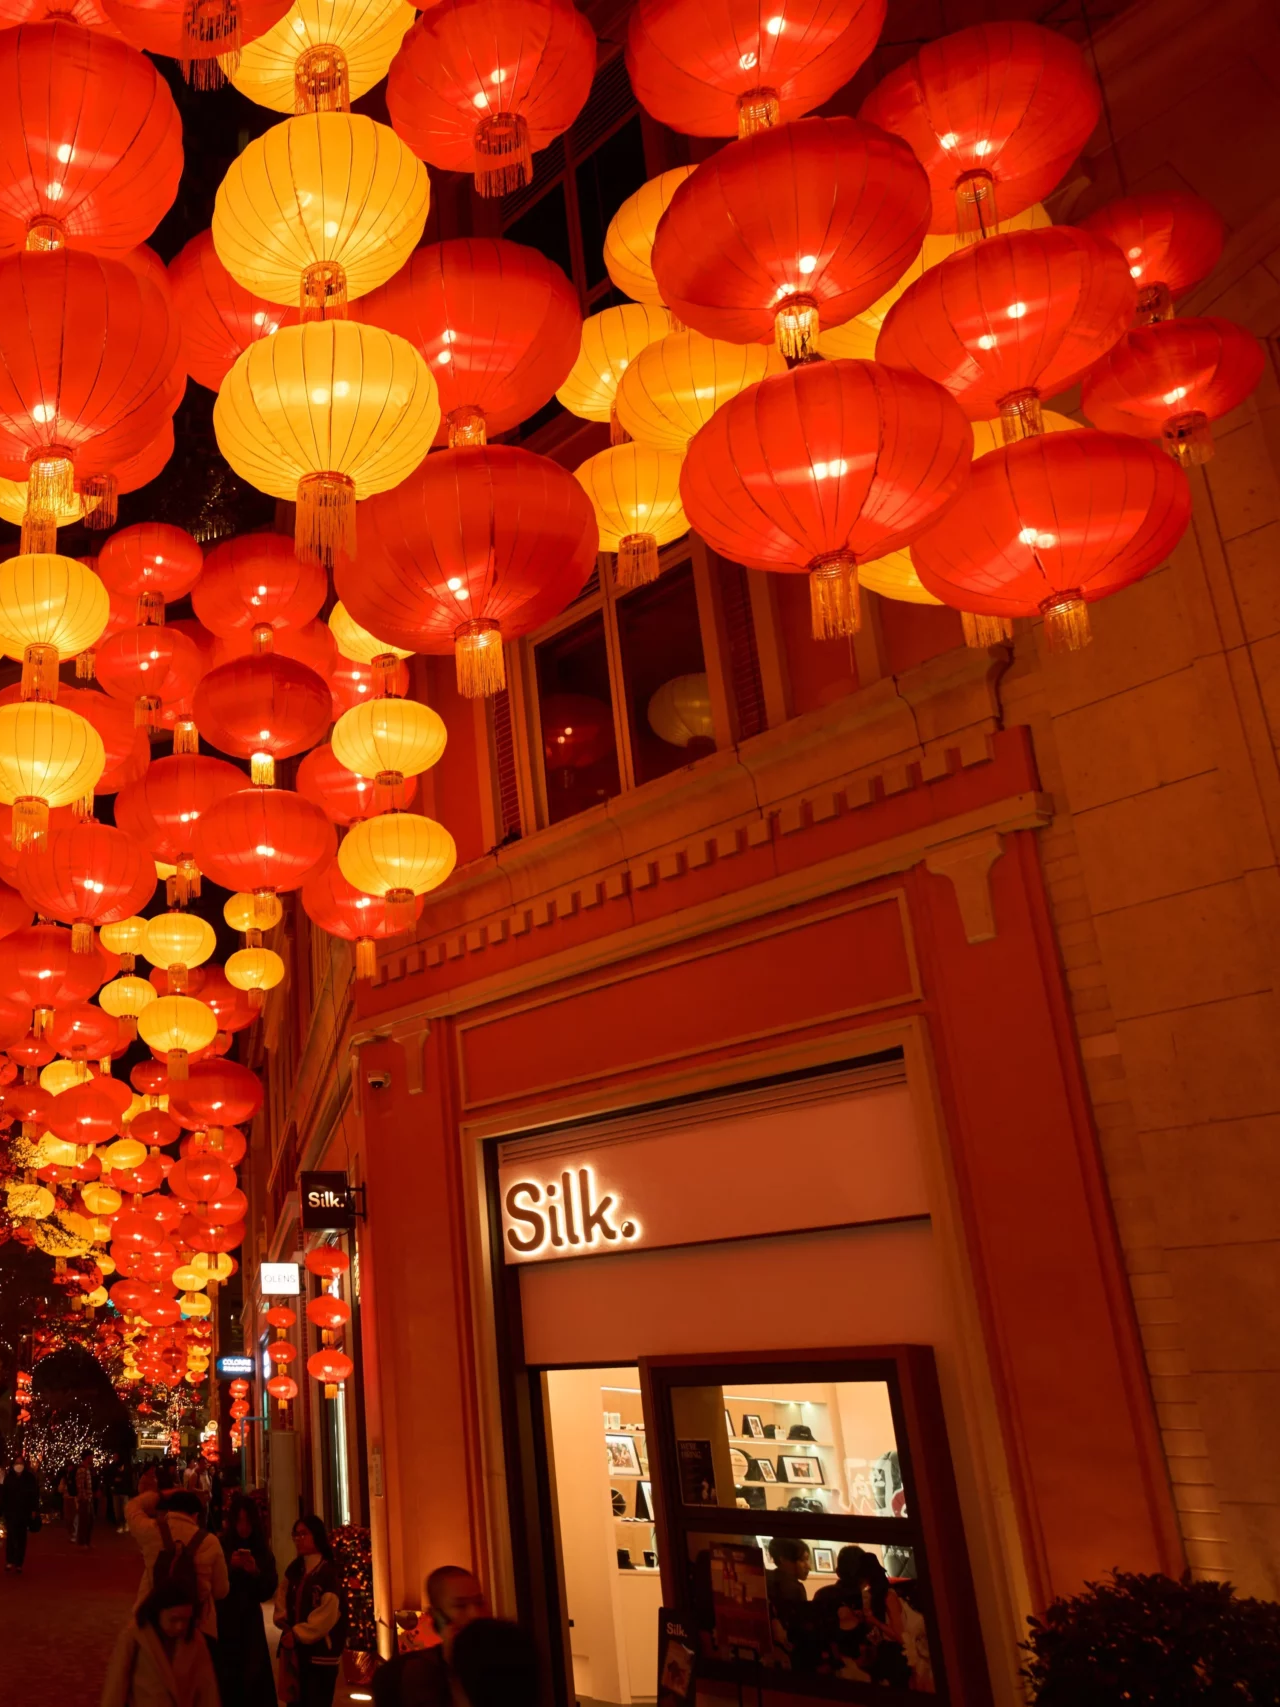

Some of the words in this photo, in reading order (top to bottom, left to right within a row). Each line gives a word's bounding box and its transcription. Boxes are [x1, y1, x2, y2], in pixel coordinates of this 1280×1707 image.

[308, 1191, 345, 1209] Silk.
[506, 1168, 636, 1252] Silk.
[666, 1622, 688, 1638] Silk.
